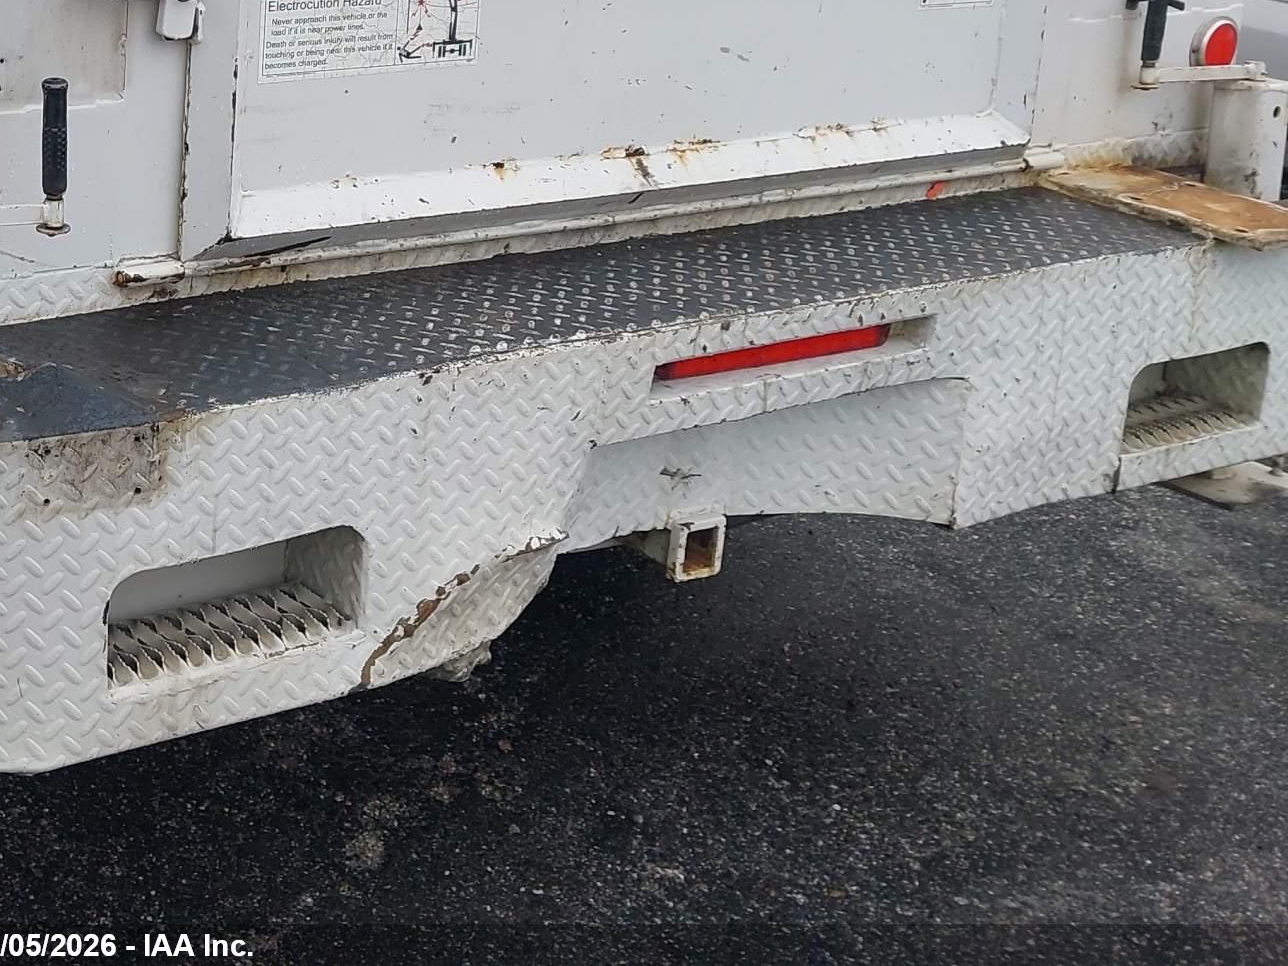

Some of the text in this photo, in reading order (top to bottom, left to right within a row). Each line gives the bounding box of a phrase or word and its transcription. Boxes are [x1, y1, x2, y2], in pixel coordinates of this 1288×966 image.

[272, 18, 293, 26] Never
[294, 16, 327, 26] approach
[342, 13, 367, 21] vehicle
[265, 61, 296, 70] becomes
